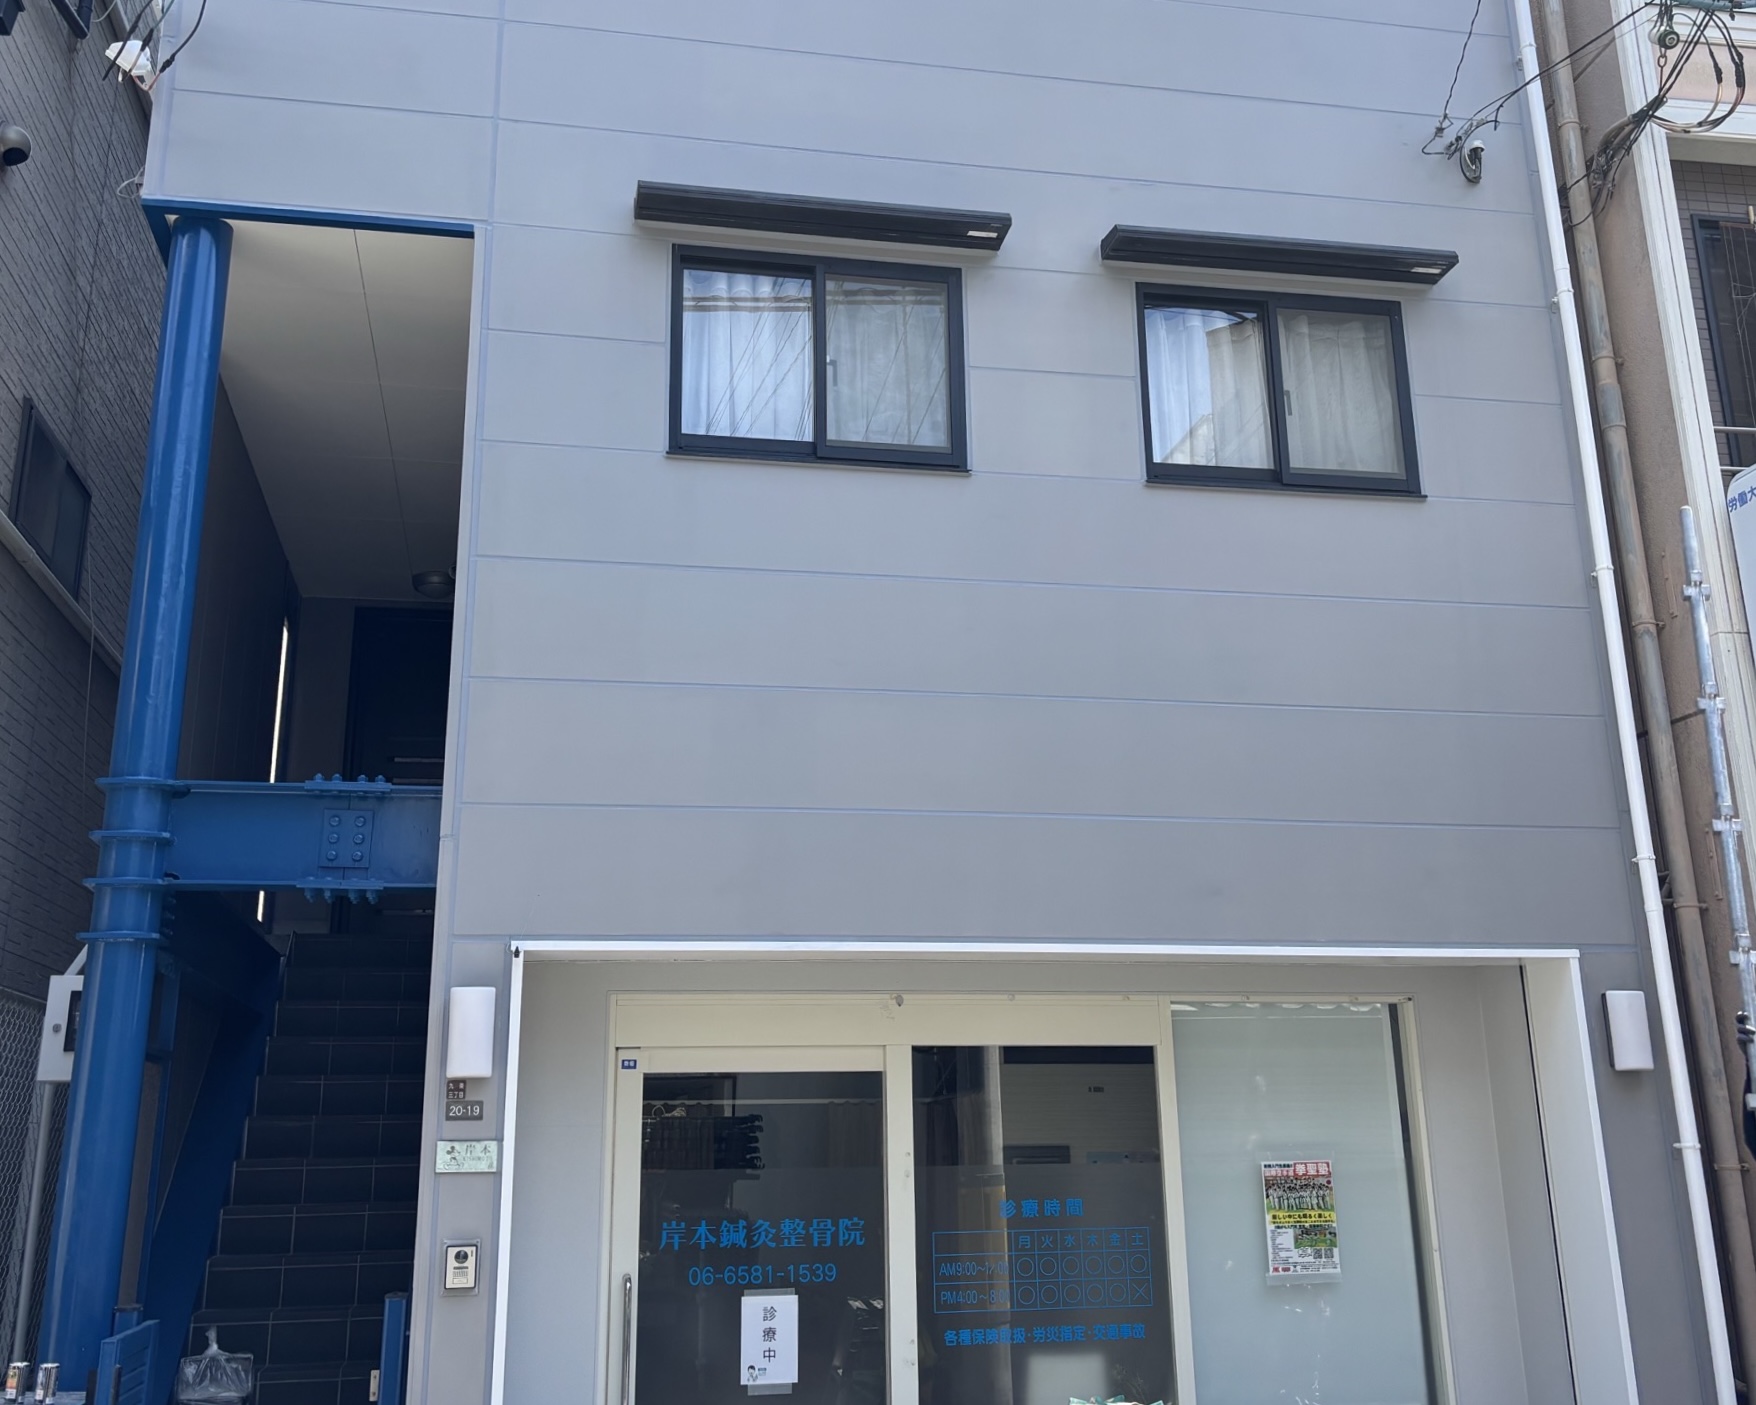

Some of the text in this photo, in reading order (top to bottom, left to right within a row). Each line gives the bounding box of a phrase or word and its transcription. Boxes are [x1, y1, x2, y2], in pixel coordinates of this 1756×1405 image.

[449, 1105, 480, 1116] 20-19
[999, 1198, 1084, 1219] 診療時間
[659, 1217, 865, 1251] 岸本鍼灸整骨院
[1018, 1232, 1144, 1249] 月 火 水 木 金 土
[688, 1263, 837, 1286] 06-6581-1539
[762, 1306, 778, 1364] 診療中
